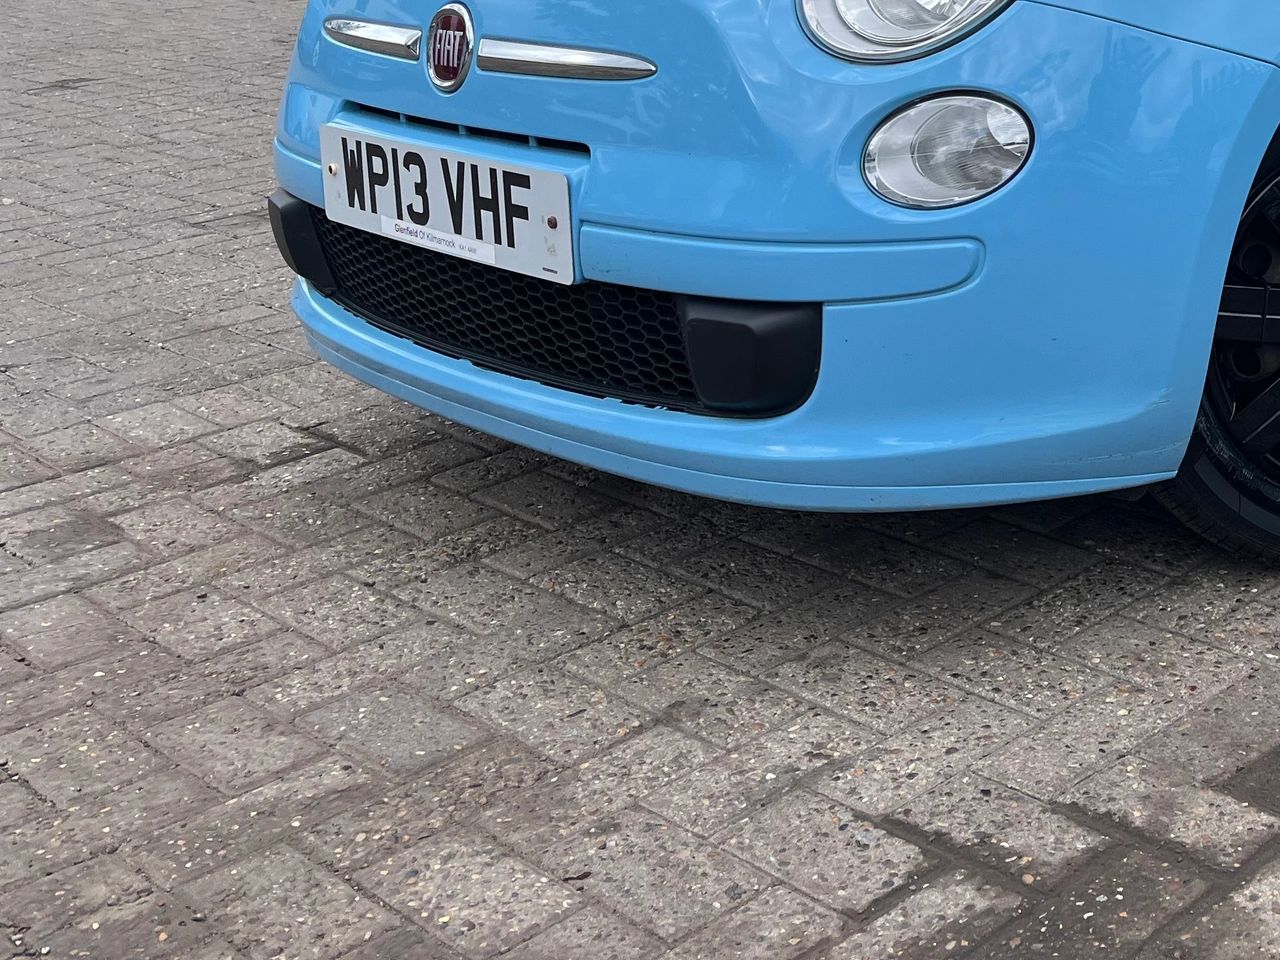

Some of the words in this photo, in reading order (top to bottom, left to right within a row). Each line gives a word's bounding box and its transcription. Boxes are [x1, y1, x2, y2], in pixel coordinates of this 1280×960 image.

[435, 29, 463, 67] FIAT
[341, 136, 430, 226] WP13
[440, 158, 531, 248] VHF
[394, 223, 418, 238] Glenfield
[426, 233, 456, 248] Kilmarnock
